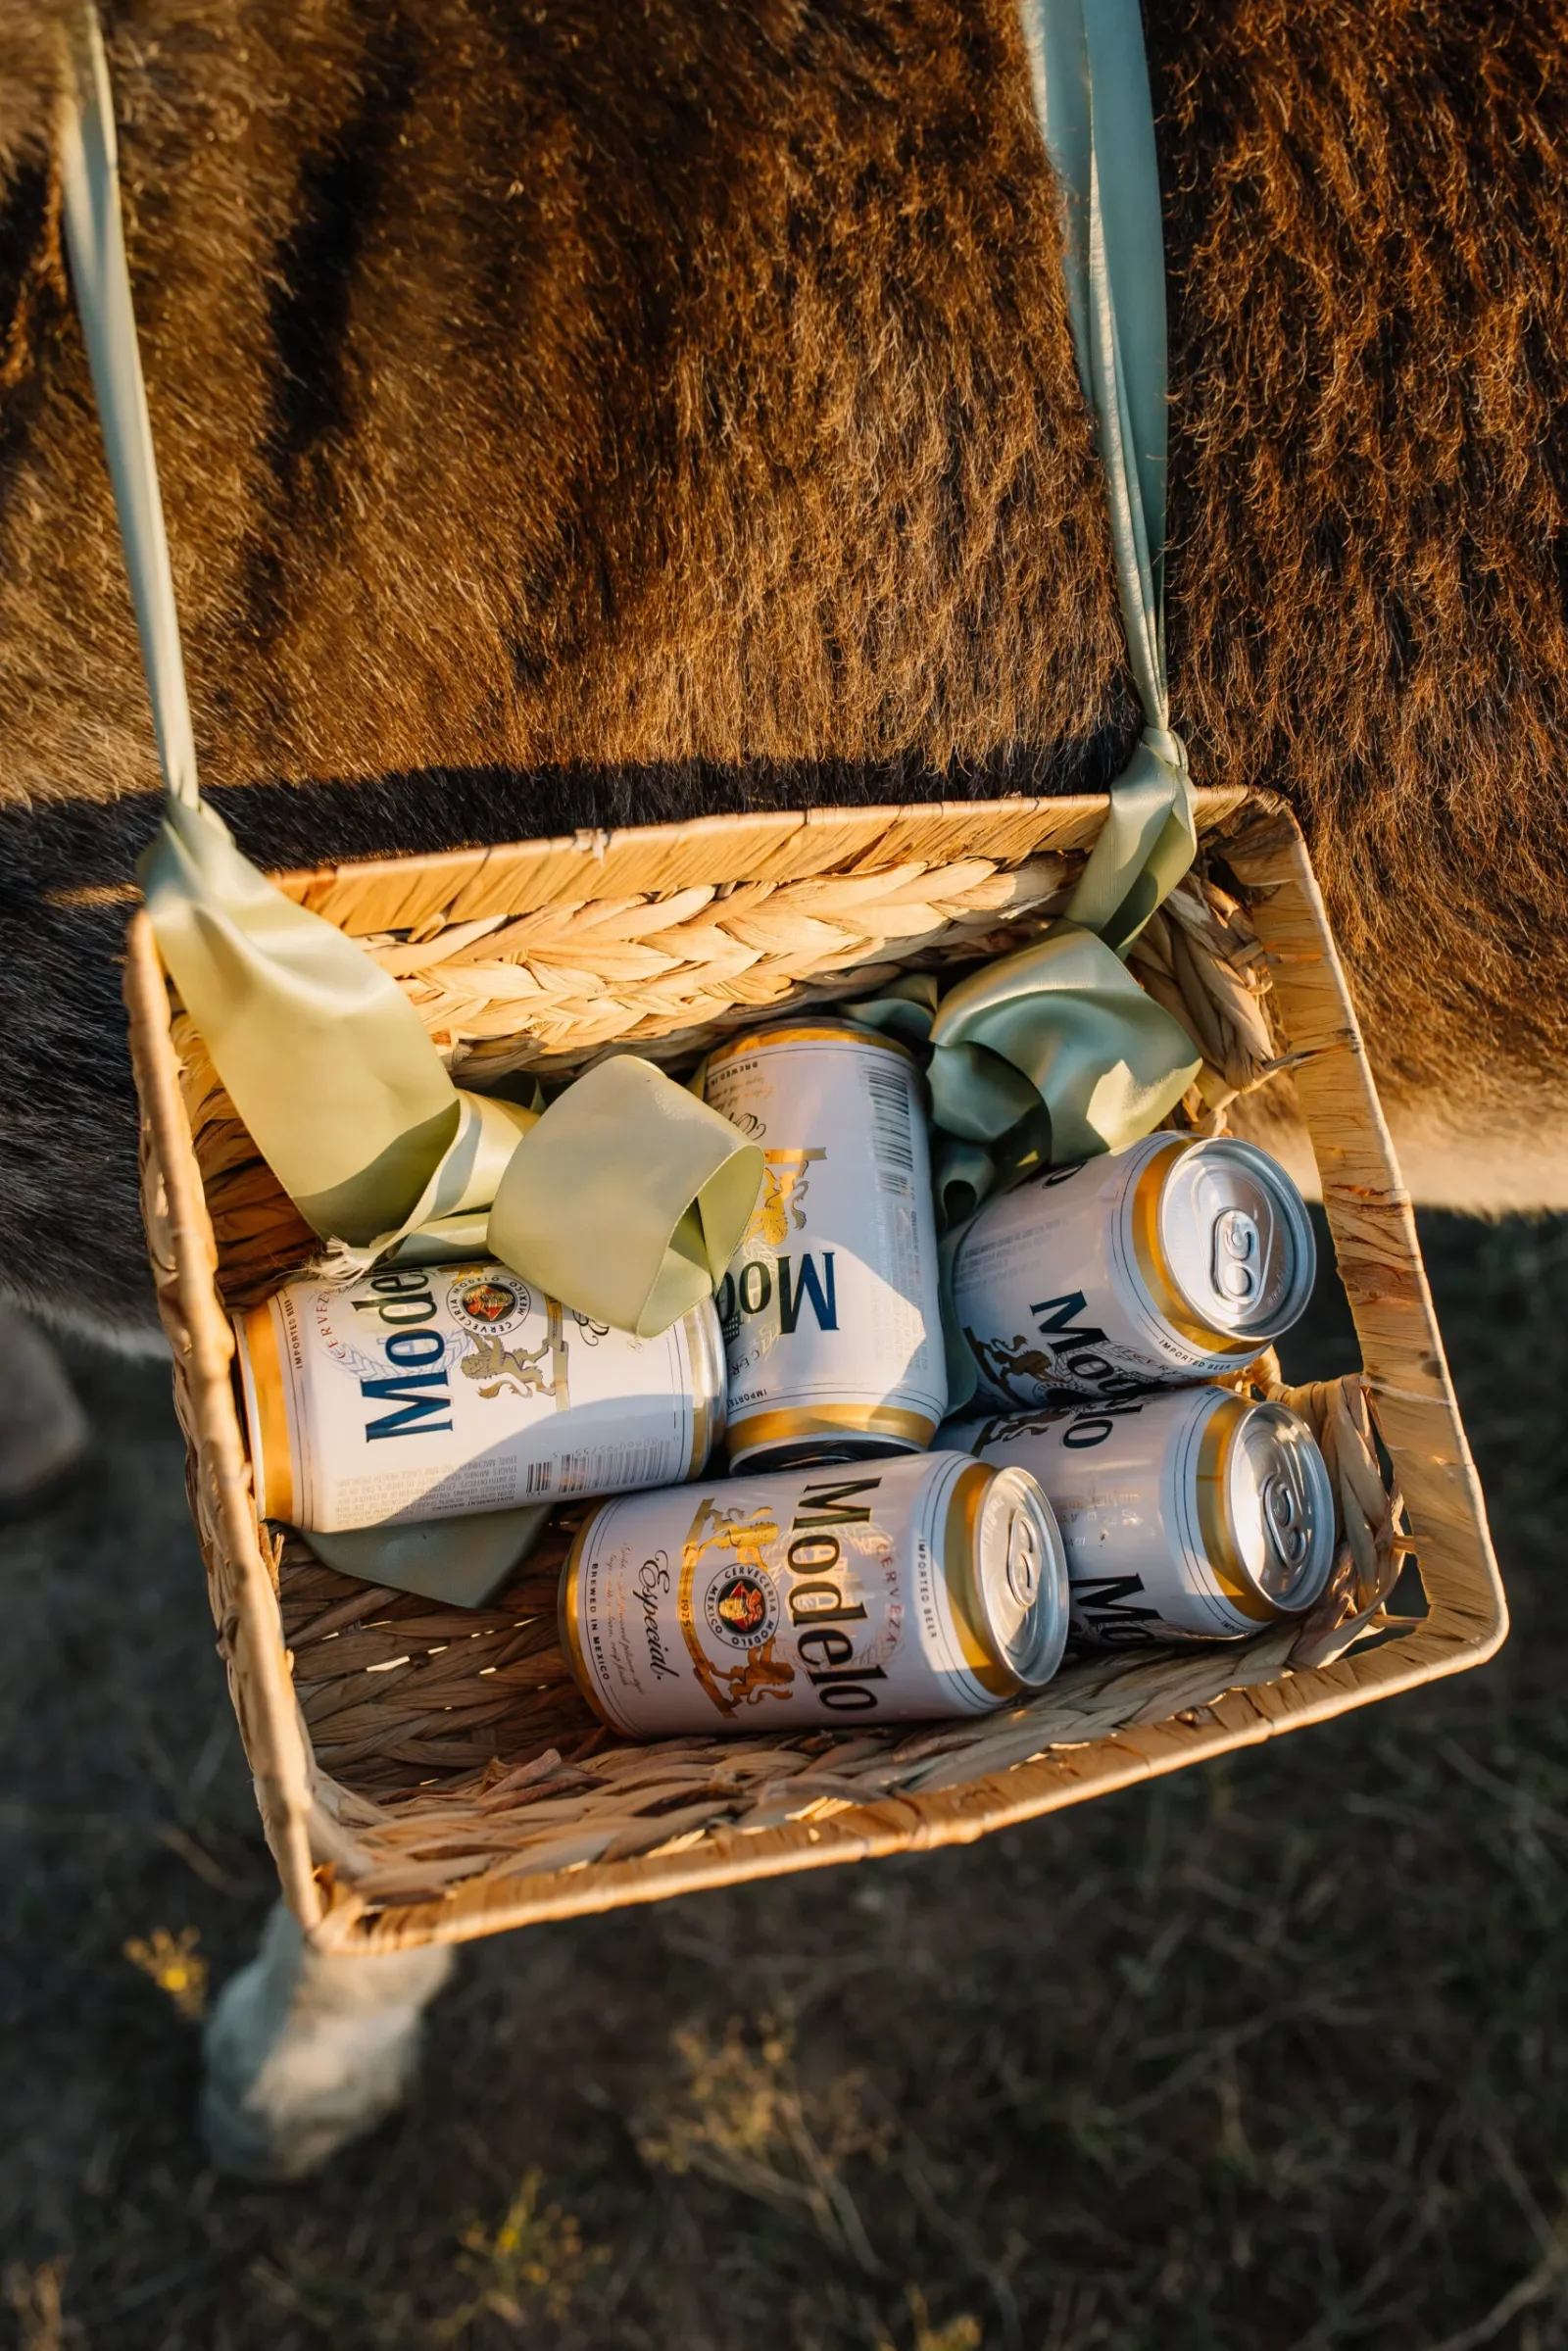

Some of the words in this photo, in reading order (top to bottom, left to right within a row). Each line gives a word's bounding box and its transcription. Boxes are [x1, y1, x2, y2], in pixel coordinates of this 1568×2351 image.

[720, 1061, 758, 1081] BREWED
[453, 1276, 500, 1294] MODELO
[509, 1281, 528, 1316] MEXICO
[286, 1298, 295, 1318] BEER
[450, 1298, 513, 1334] CERVECERIA
[289, 1318, 303, 1369] IMPORTED
[1157, 1339, 1207, 1371] IMPORTED
[727, 1389, 767, 1407] IMPORTE
[589, 1563, 599, 1613] BREWED
[917, 1539, 930, 1602] IMPORTED
[724, 1566, 777, 1612] CERVECERIA
[786, 1477, 890, 1713] Modelo
[876, 1543, 903, 1643] CERVEZA
[590, 1619, 598, 1631] IN
[680, 1598, 691, 1628] 1925
[707, 1585, 723, 1634] MEXICO
[923, 1608, 938, 1639] BEER
[731, 1620, 775, 1646] MODELO
[593, 1637, 611, 1681] MEXICO
